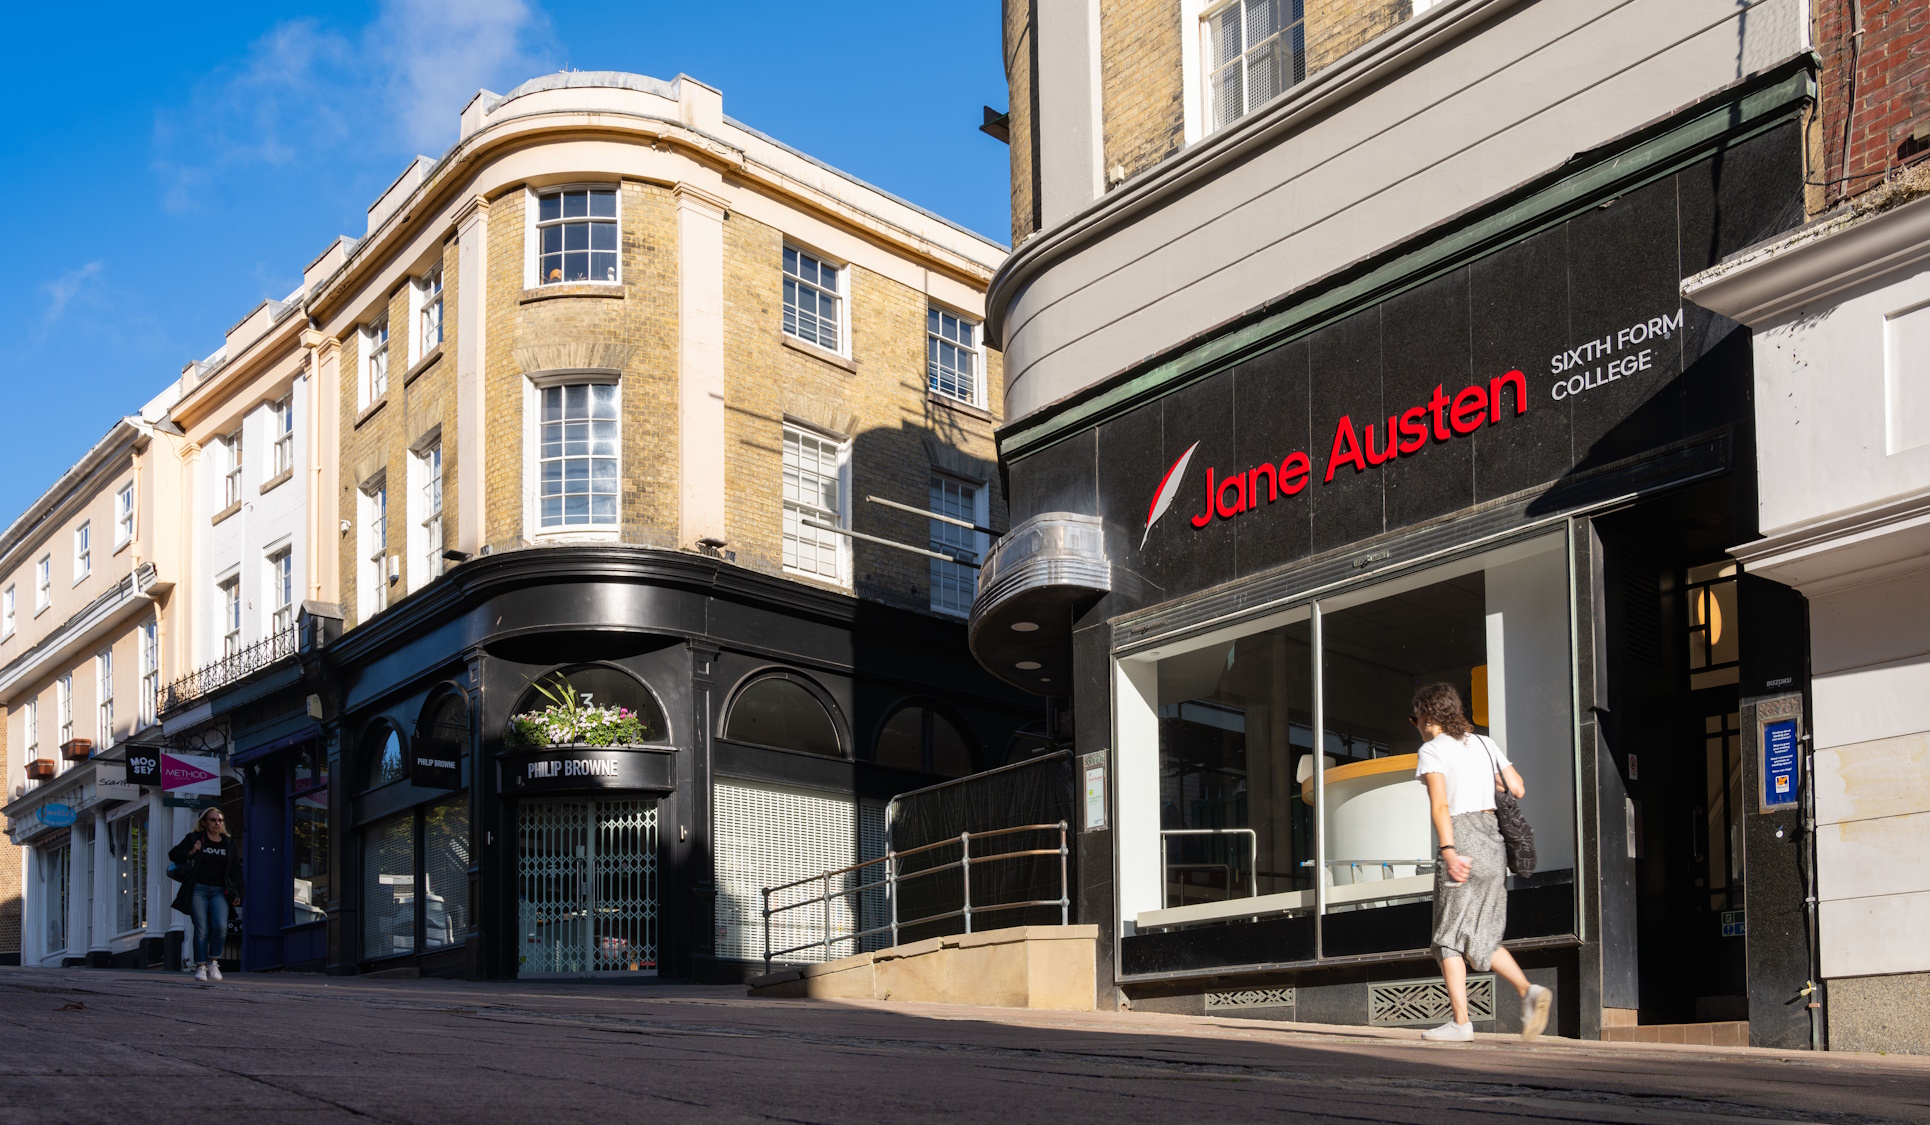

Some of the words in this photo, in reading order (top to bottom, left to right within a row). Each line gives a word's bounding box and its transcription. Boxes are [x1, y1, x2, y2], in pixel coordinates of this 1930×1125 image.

[1551, 335, 1611, 374] SIXTH
[1617, 308, 1684, 350] FORM
[1551, 348, 1652, 401] COLLEGE
[1191, 451, 1311, 528] Jane
[1324, 369, 1528, 483] Austen
[130, 756, 156, 767] MOO
[417, 757, 434, 767] PHILIP
[434, 759, 456, 769] BROWNE
[528, 760, 562, 779] PHILIP
[564, 759, 618, 777] BROWNE
[134, 765, 154, 775] SEY
[165, 769, 208, 779] METHOD
